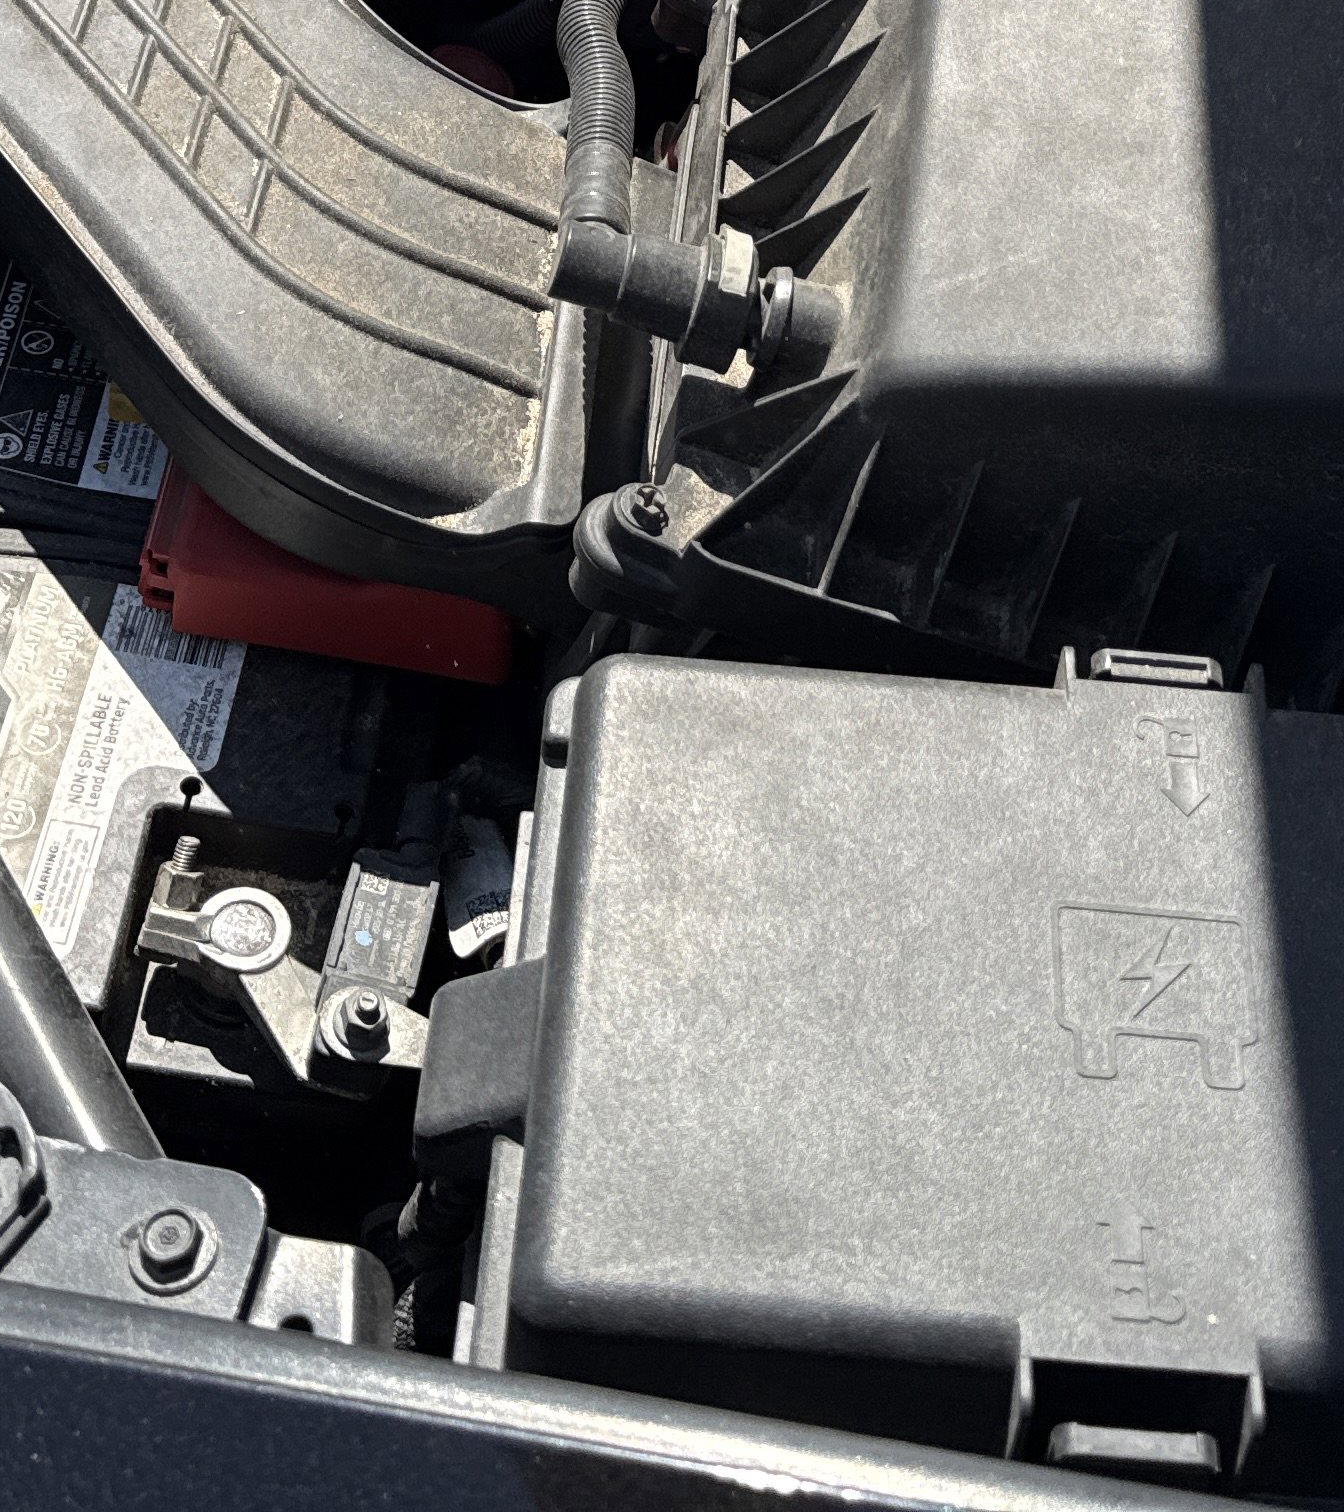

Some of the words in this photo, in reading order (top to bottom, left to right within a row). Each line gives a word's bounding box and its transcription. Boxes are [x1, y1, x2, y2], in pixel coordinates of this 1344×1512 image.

[23, 432, 42, 463] SHIELD
[39, 420, 63, 465] EXPLOSIVE
[53, 392, 71, 421] GASES
[53, 450, 67, 466] CAN
[14, 582, 59, 674] PLATINUM
[43, 619, 83, 692] H6-AGM
[102, 695, 131, 746] Battery
[186, 723, 202, 759] Advance
[195, 702, 208, 723] Auto
[206, 714, 216, 727] NC
[65, 691, 114, 804] NON-SPILLABLE
[94, 745, 114, 774] Acid
[0, 796, 27, 834] 120
[84, 773, 106, 808] Lead
[33, 839, 60, 902] WARNING:
